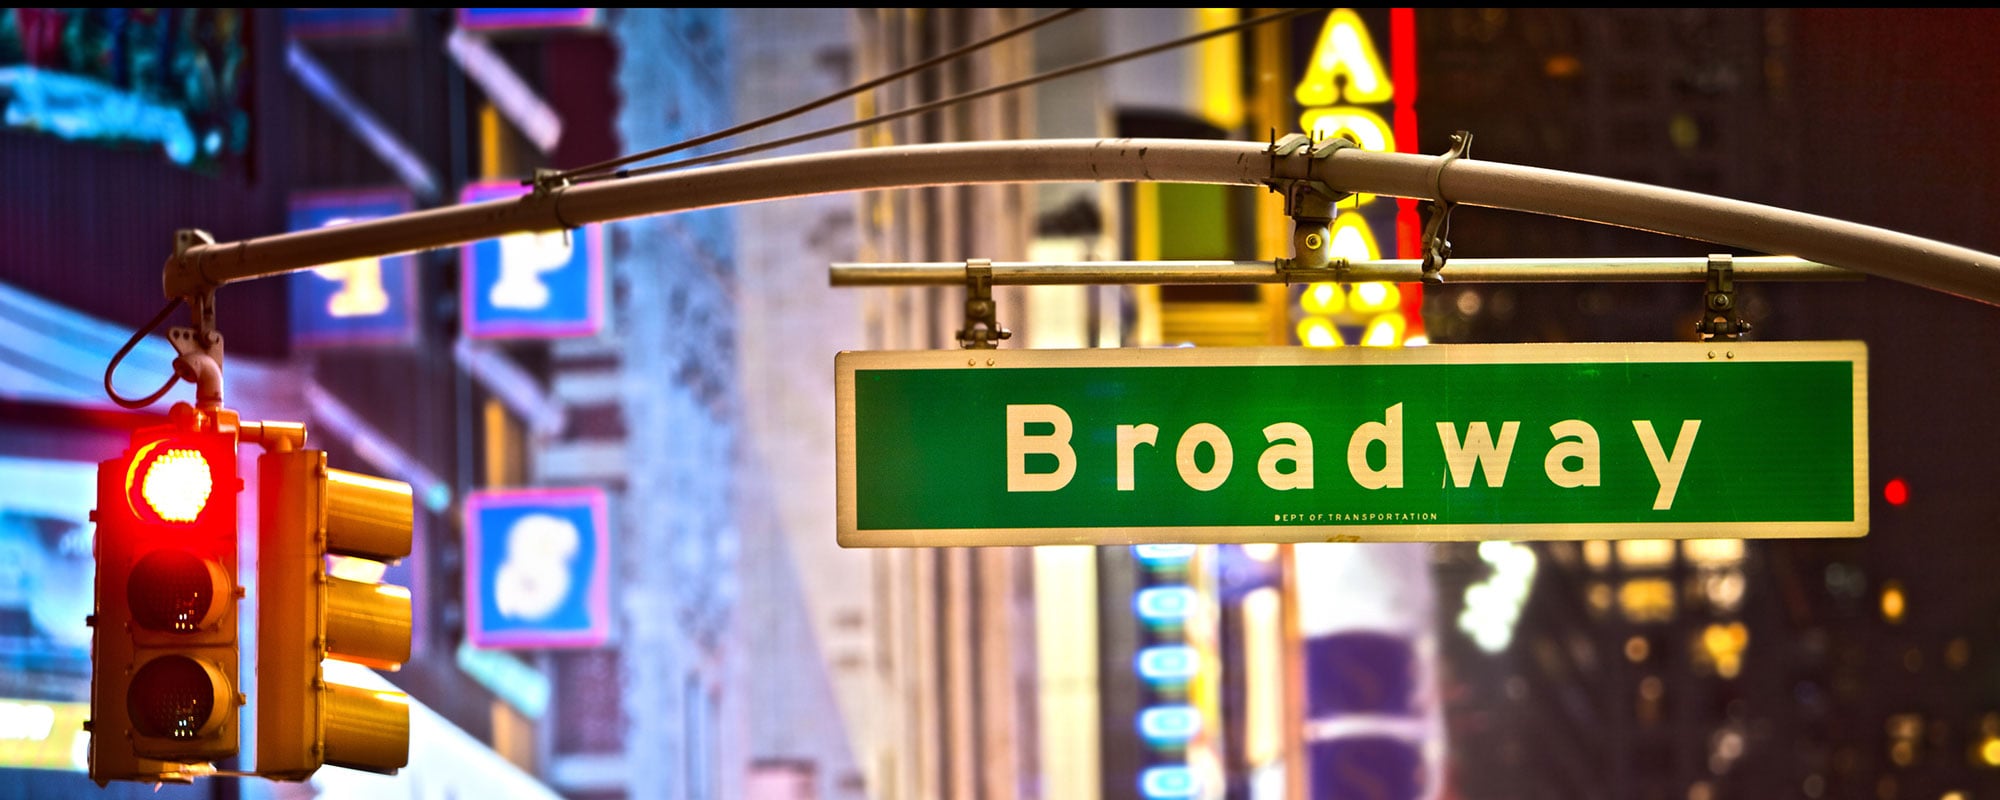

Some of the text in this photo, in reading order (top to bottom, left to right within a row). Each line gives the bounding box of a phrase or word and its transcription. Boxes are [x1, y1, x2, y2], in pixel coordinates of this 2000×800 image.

[1007, 402, 1701, 510] Broadway
[1274, 512, 1438, 522] DEPT OF TRANSPORTATION
